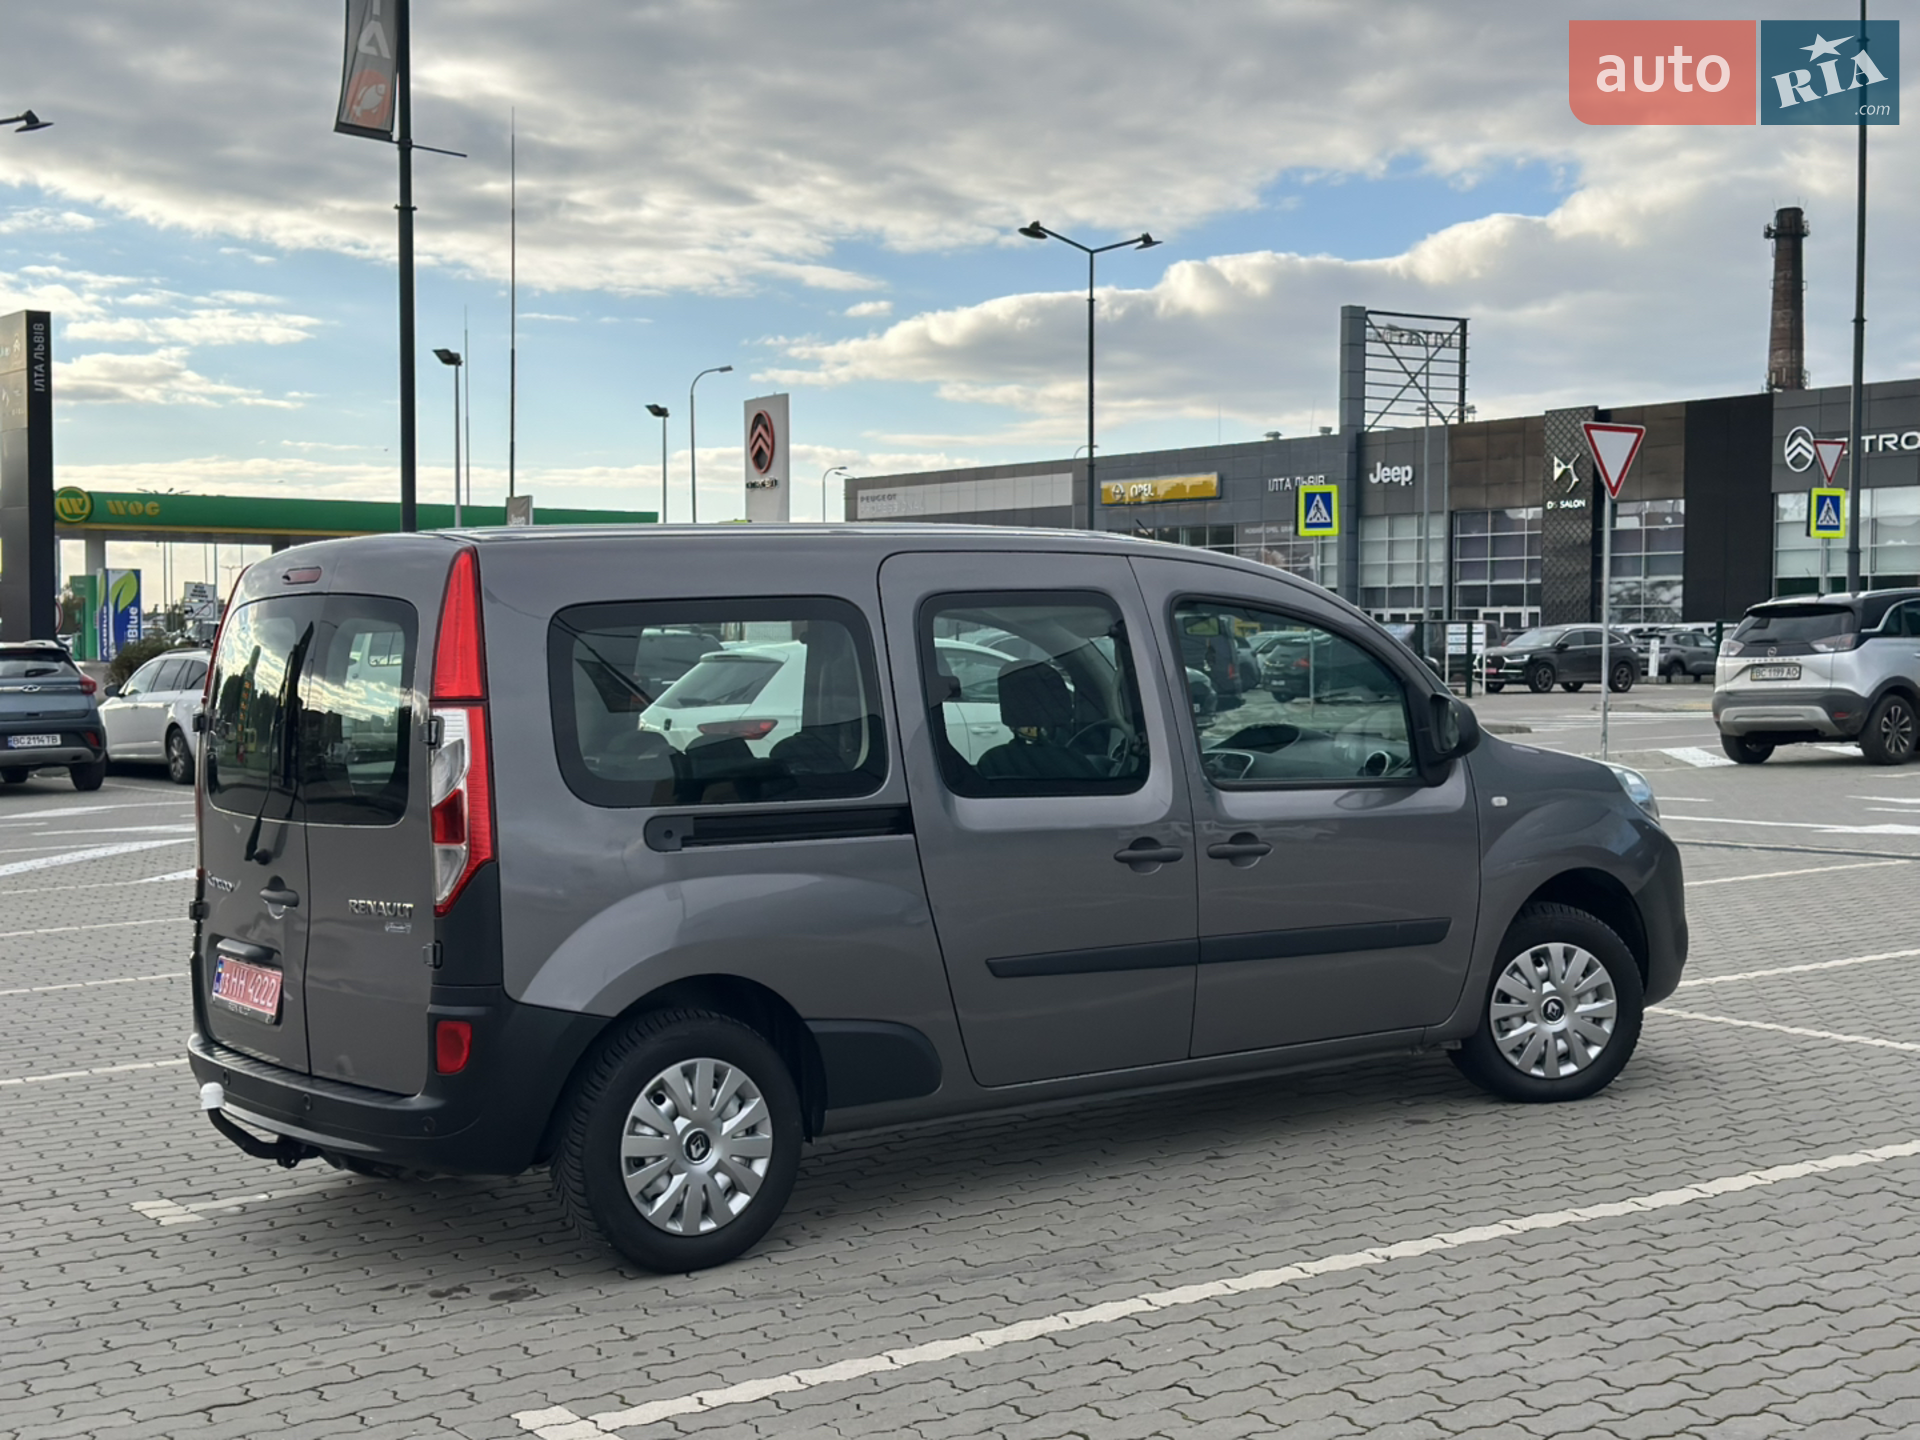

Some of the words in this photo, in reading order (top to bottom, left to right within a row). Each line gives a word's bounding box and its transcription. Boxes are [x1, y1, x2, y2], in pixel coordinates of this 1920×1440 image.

[33, 323, 45, 361] ЛЬВІВ
[33, 363, 45, 392] ІЛТА
[1369, 461, 1413, 486] Jeep
[1130, 483, 1155, 498] OPEL
[1268, 477, 1292, 491] ІЛТА
[860, 493, 897, 503] PEUGEOT
[1559, 499, 1586, 509] SALON
[106, 500, 161, 516] WOG
[348, 899, 414, 919] RENAULT
[248, 973, 278, 1008] 4222
